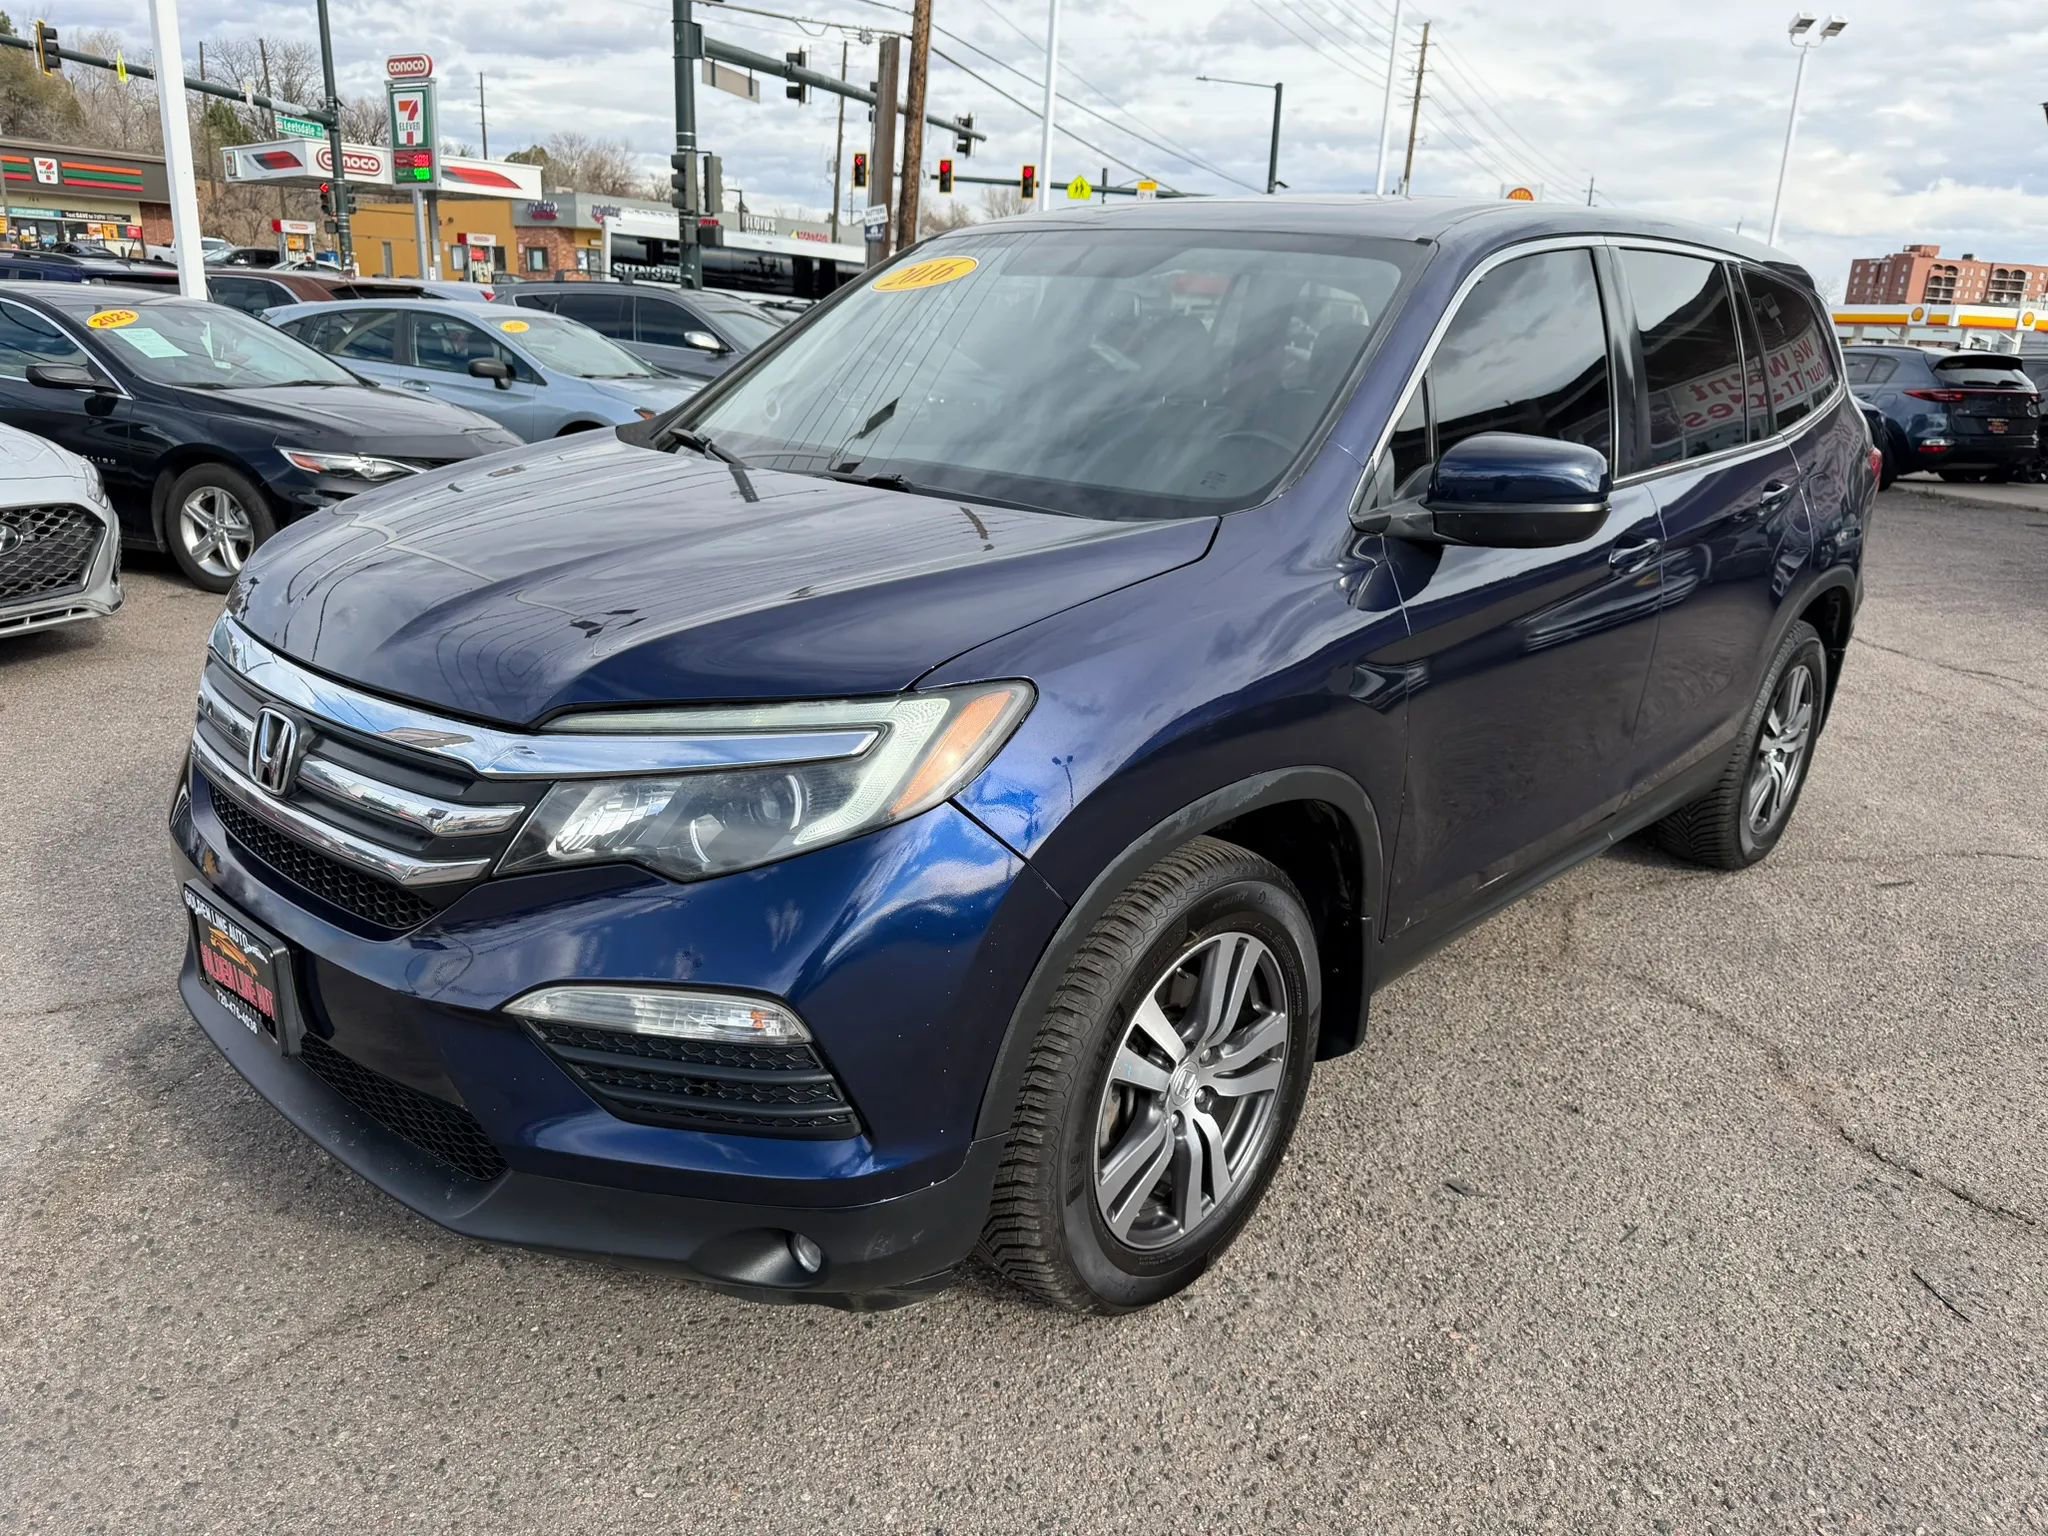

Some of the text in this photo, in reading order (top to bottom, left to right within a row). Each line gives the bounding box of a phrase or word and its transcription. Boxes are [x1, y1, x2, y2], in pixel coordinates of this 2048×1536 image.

[283, 120, 315, 137] Leetsdale
[399, 121, 421, 132] ELEVEN
[323, 154, 378, 171] cnoco
[879, 259, 970, 287] 2016
[93, 310, 134, 326] 2023
[229, 923, 249, 949] AUTO
